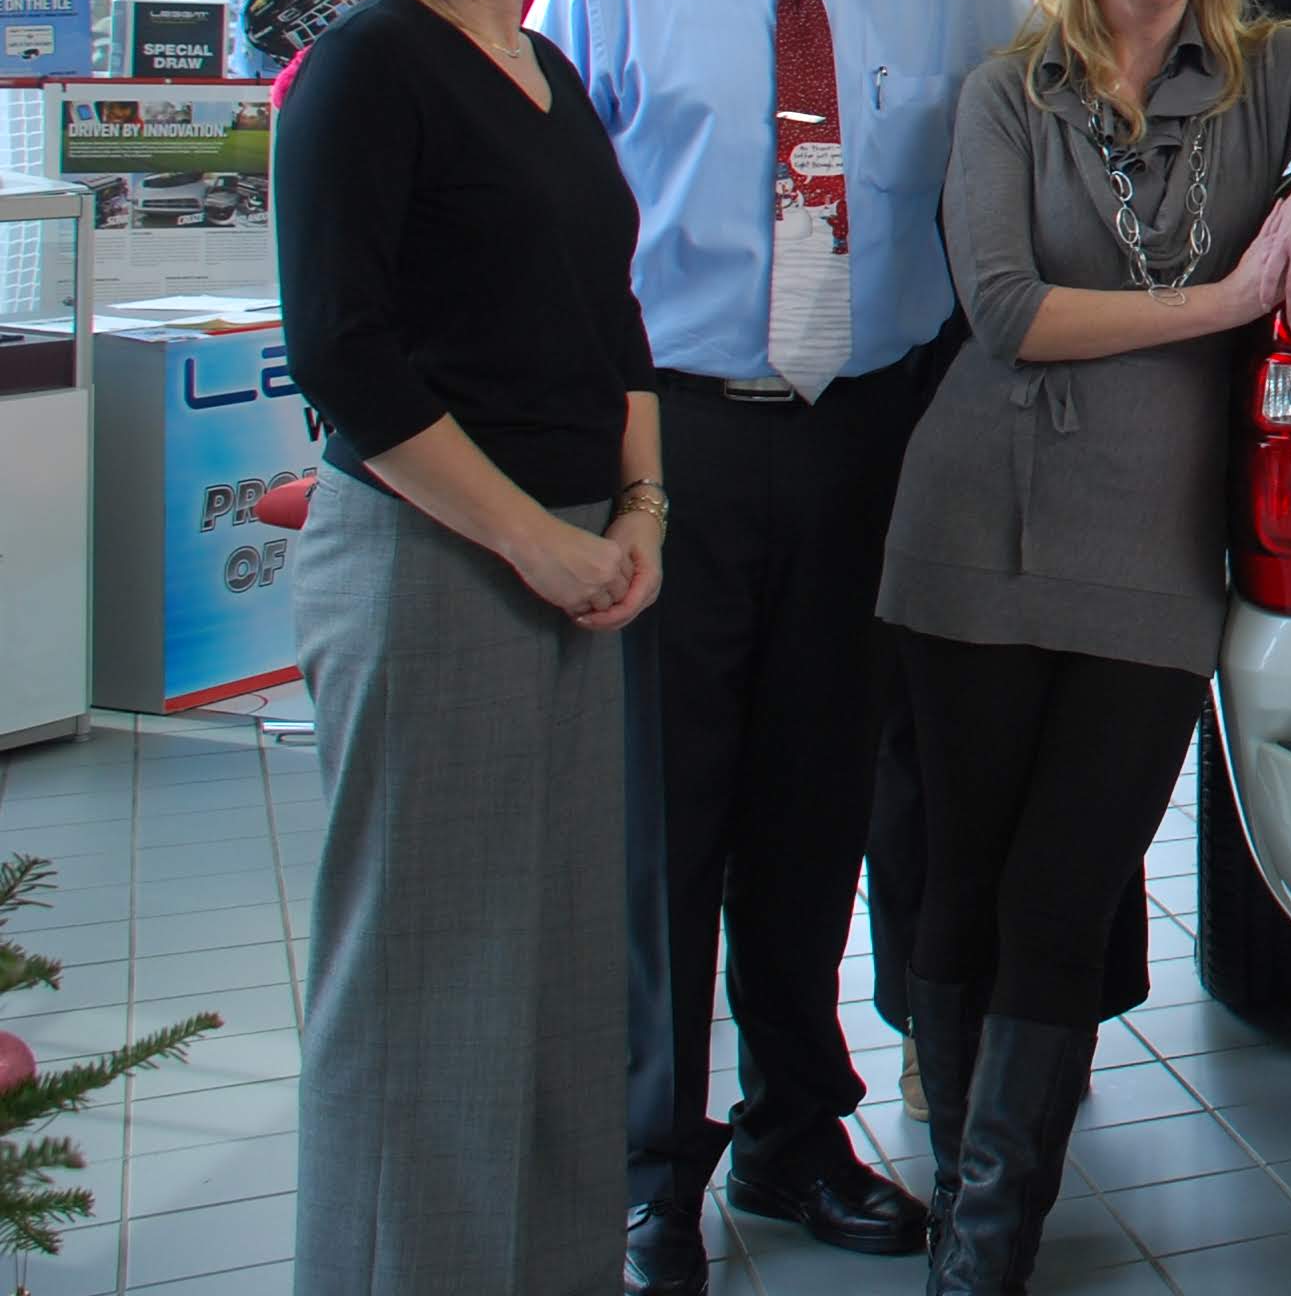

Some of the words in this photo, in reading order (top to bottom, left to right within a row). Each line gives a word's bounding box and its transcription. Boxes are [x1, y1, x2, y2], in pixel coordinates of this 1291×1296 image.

[143, 43, 214, 57] SPECIAL
[153, 57, 203, 71] DRAW
[69, 123, 119, 138] DRIVEN
[122, 123, 141, 137] BY
[143, 123, 228, 137] INNOVATION.
[223, 538, 288, 593] OF
